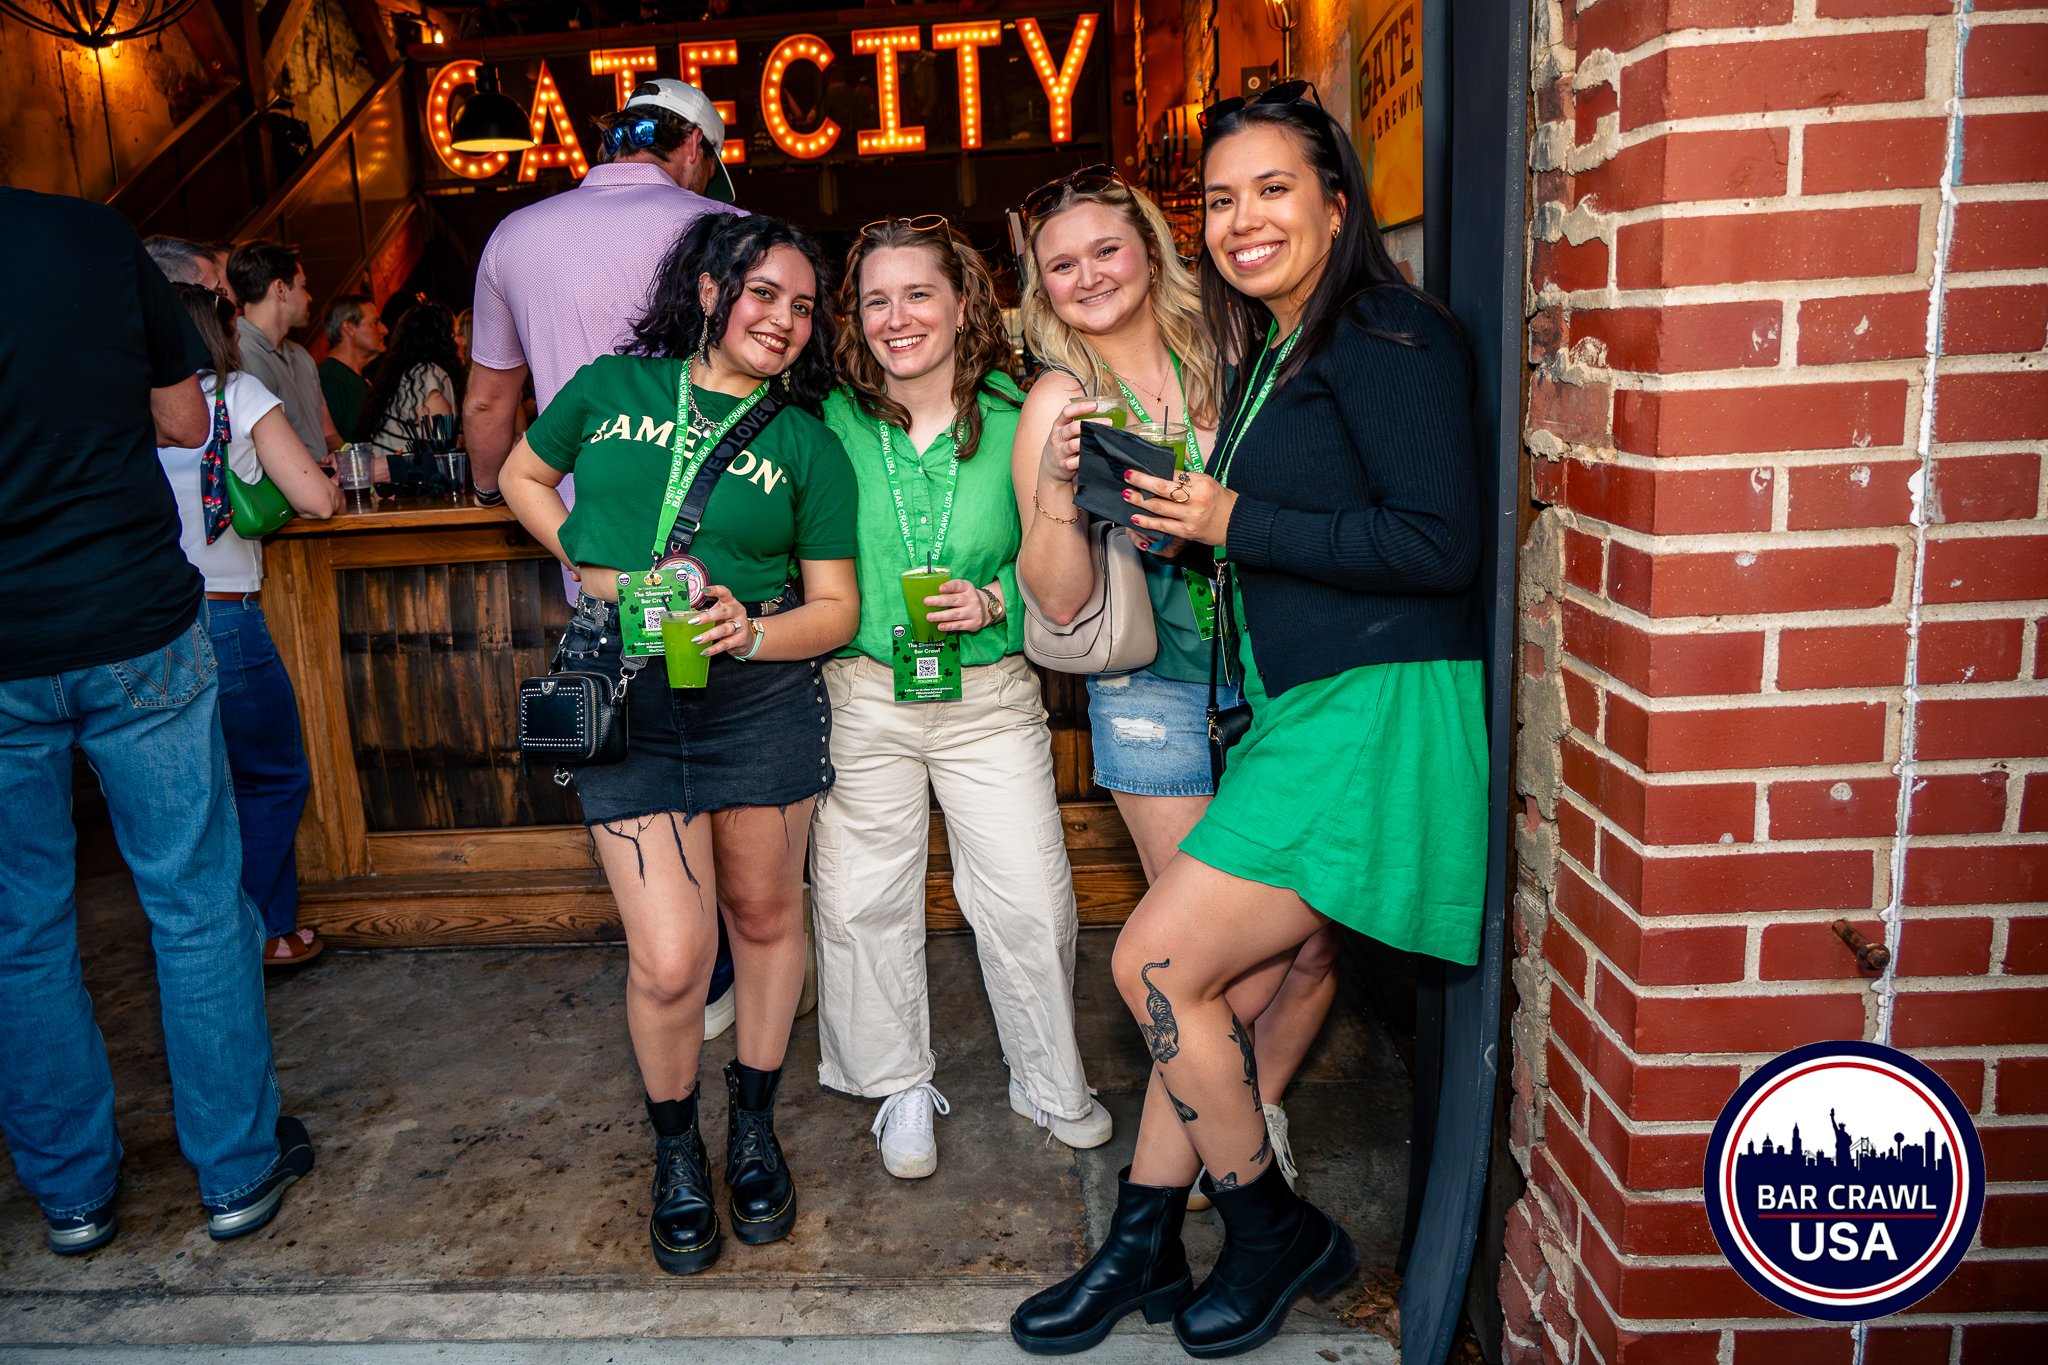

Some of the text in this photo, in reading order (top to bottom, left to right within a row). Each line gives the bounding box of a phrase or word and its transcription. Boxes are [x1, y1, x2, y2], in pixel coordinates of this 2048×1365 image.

[1359, 3, 1414, 122] GATE
[726, 407, 769, 448] LOVE
[671, 489, 686, 508] BAR
[680, 461, 700, 489] CRAWL
[695, 446, 711, 463] USA
[715, 421, 730, 438] BAR
[728, 402, 750, 424] CRAWL
[747, 393, 760, 406] USA
[674, 436, 685, 454] BAR
[880, 425, 891, 456] CRAWL
[1187, 432, 1200, 463] CRAWL
[669, 455, 683, 484] CRAWL
[885, 457, 896, 475] USA
[948, 457, 959, 476] BAR
[665, 486, 676, 505] USA
[893, 489, 904, 509] BAR
[943, 490, 953, 509] USA
[898, 509, 912, 542] CRAWL
[938, 510, 951, 541] CRAWL
[906, 540, 915, 559] USA
[932, 541, 943, 560] BAR
[645, 589, 674, 597] Shamrock
